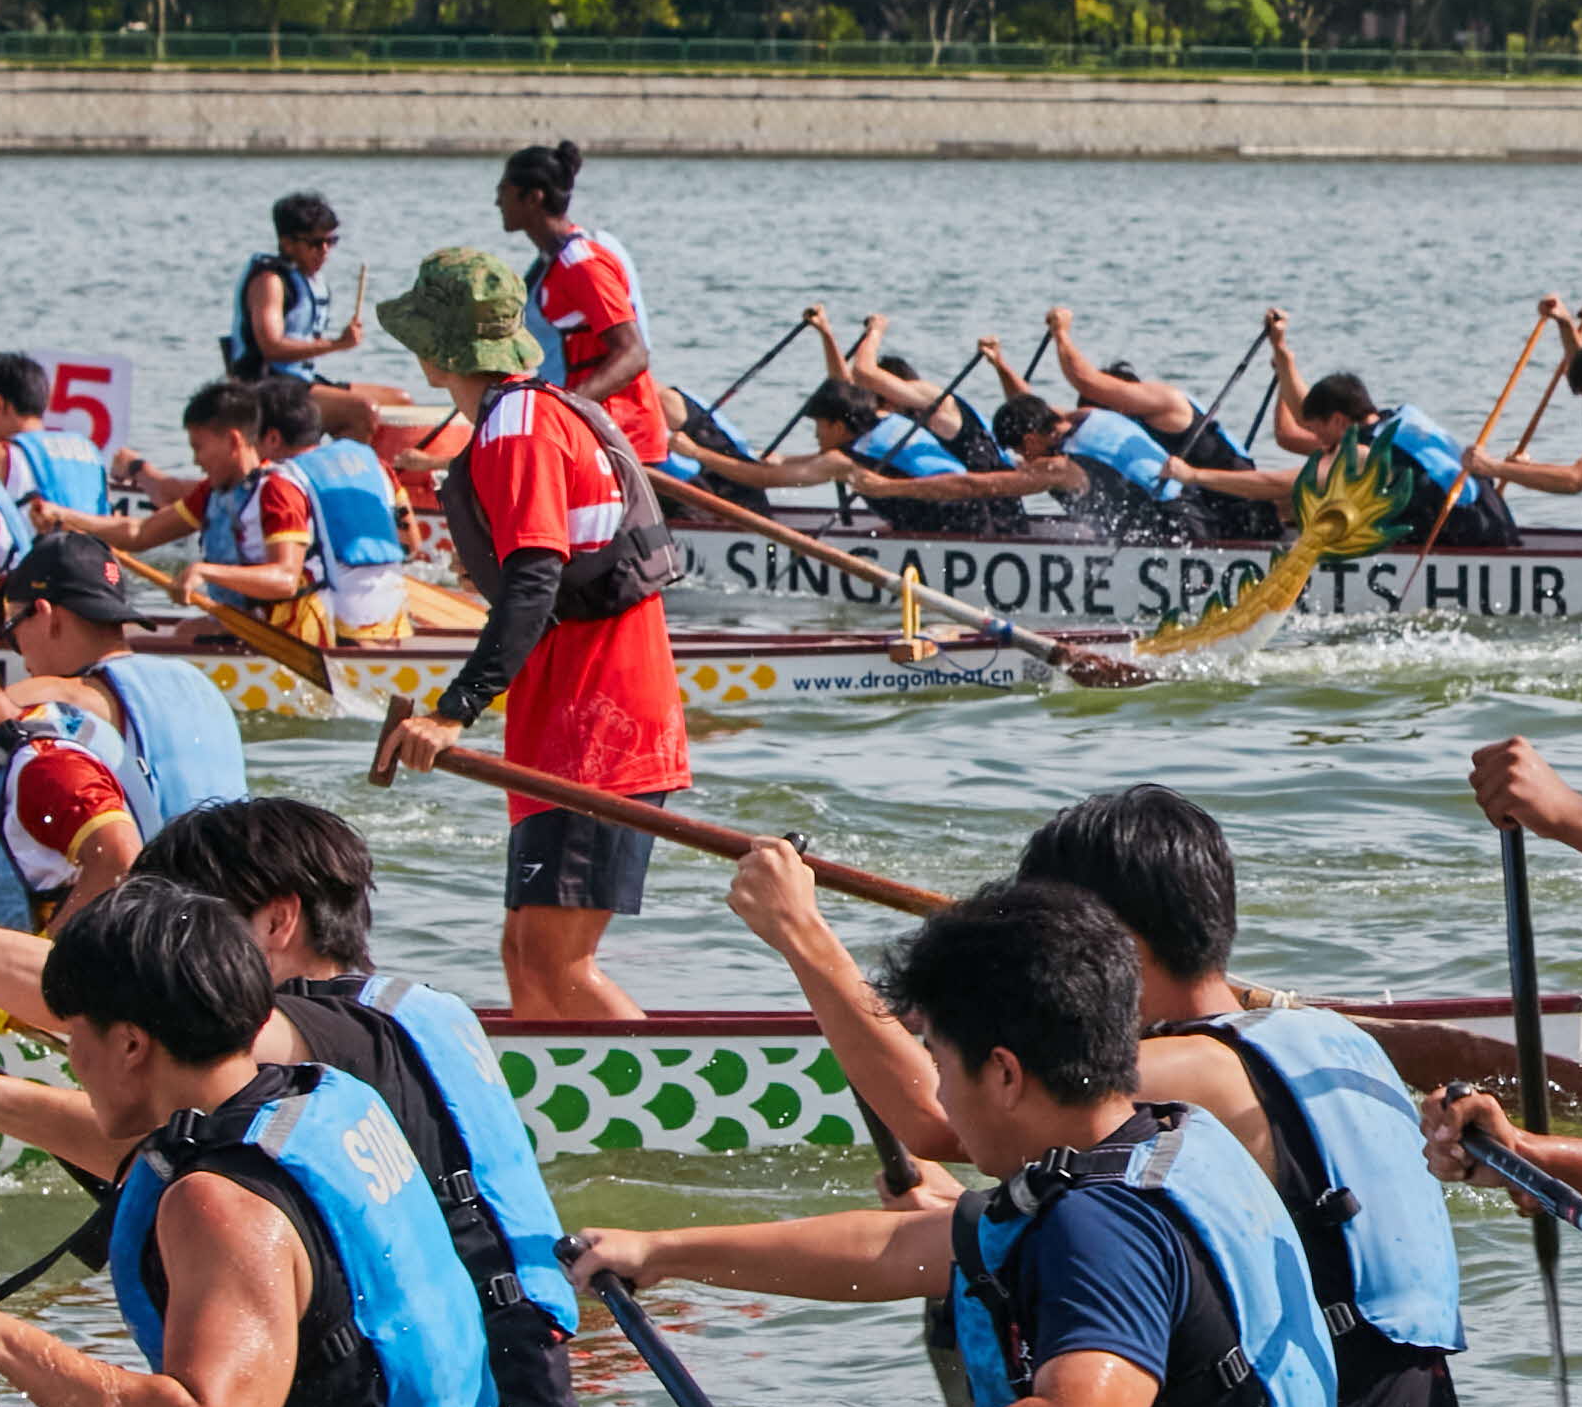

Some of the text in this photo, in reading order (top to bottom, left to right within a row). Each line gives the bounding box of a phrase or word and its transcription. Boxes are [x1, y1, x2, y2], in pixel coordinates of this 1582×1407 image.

[50, 362, 112, 451] 5
[1137, 556, 1402, 615] SPOTS
[1425, 563, 1568, 616] HUB
